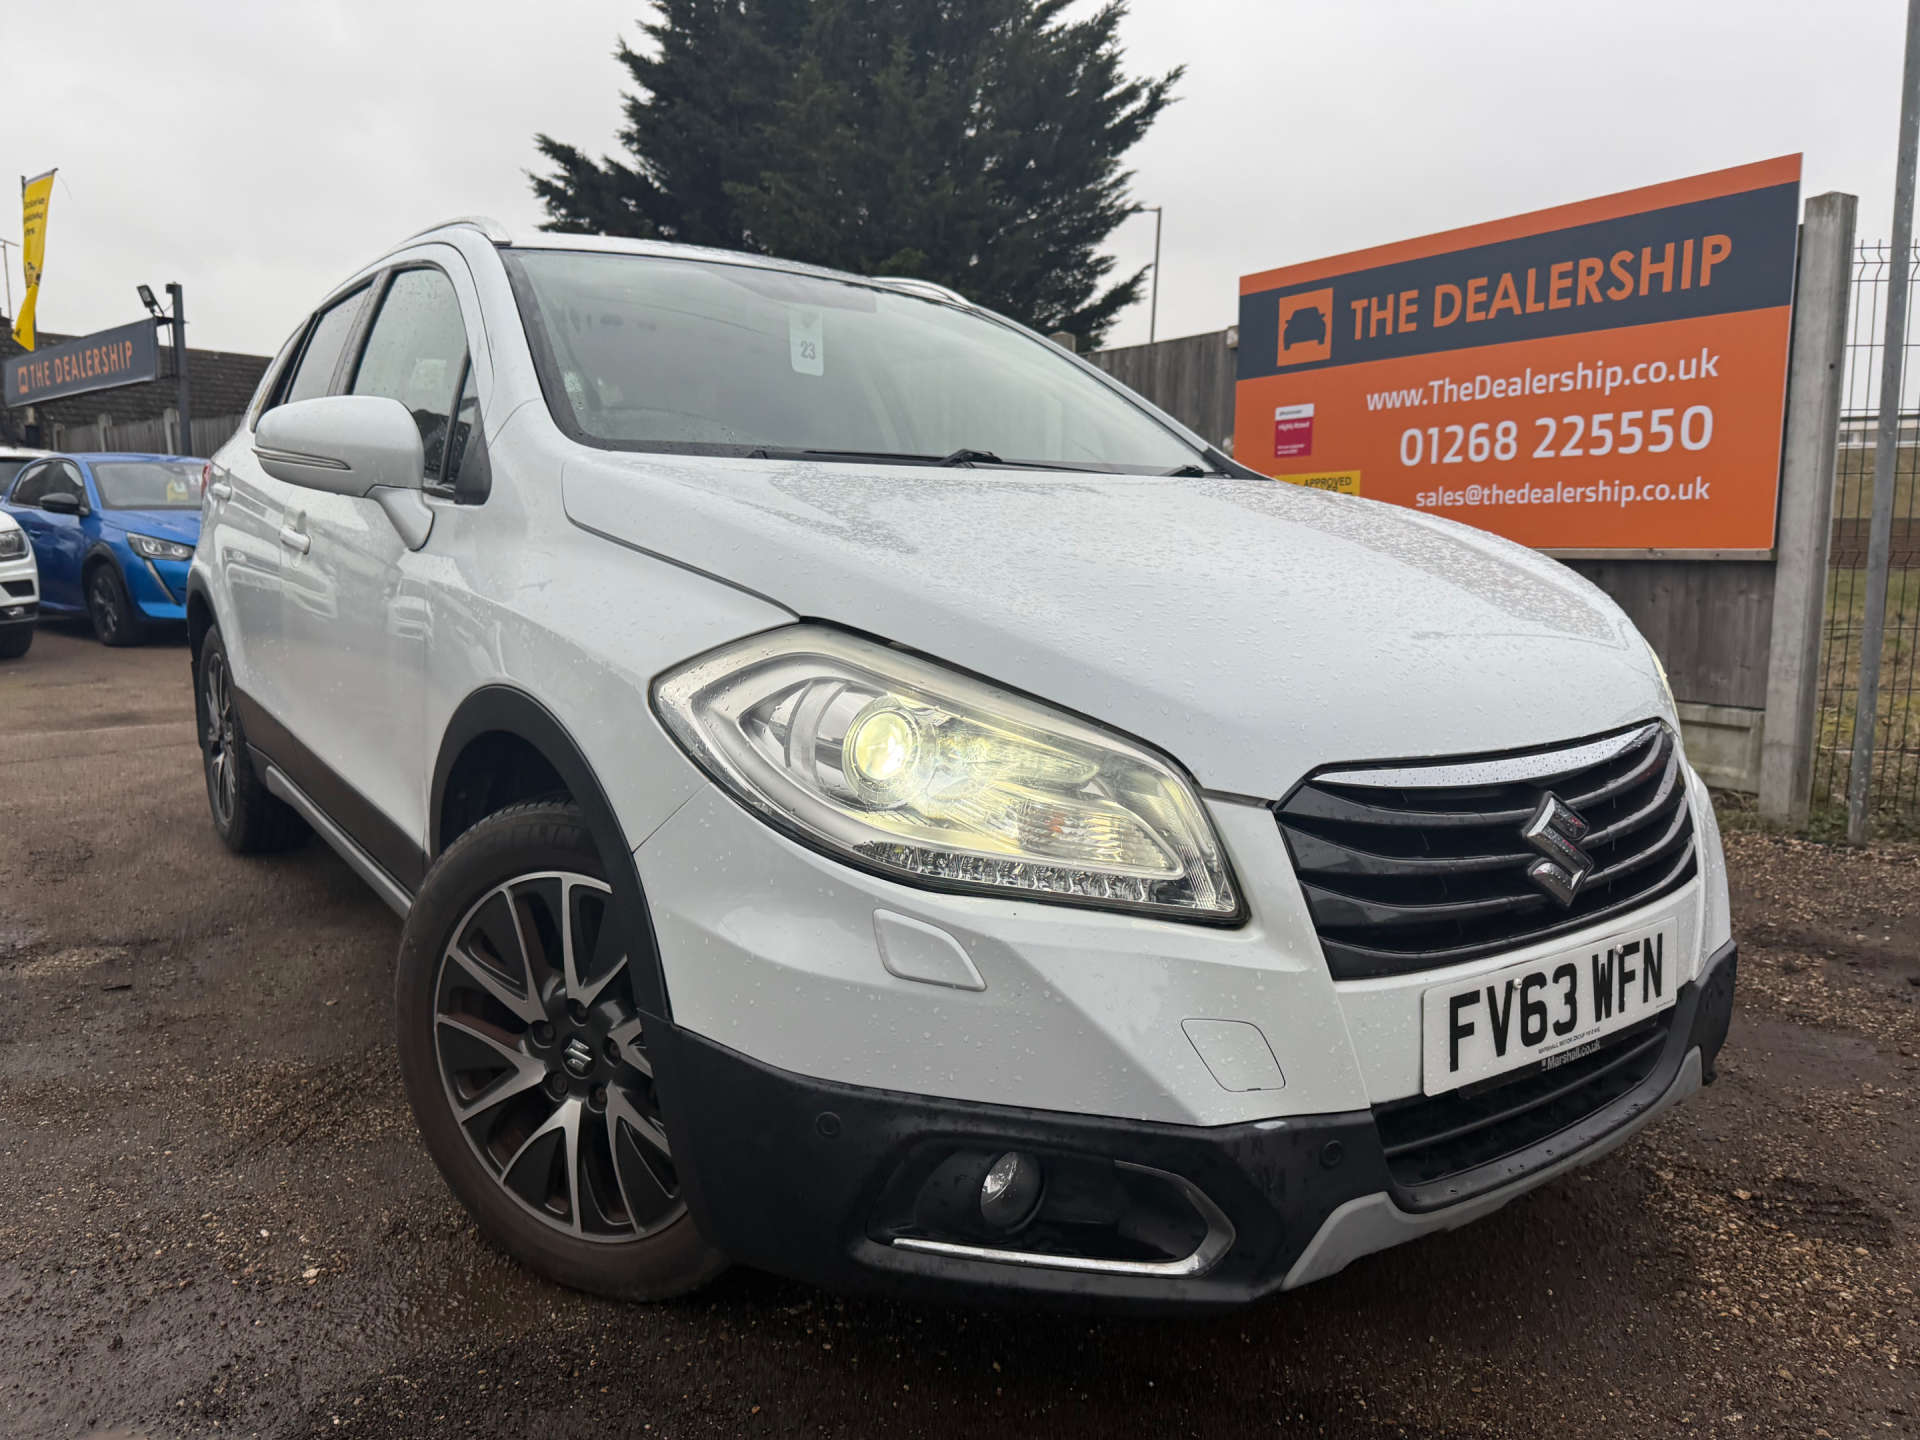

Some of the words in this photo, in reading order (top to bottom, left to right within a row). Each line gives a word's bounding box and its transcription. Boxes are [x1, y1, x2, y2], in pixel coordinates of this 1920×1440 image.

[1351, 289, 1419, 340] THE
[1433, 233, 1732, 328] DEALERSHIP
[30, 361, 51, 388] THE
[54, 341, 132, 384] DEALERSHIP
[800, 340, 816, 360] 23
[1366, 347, 1720, 411] www.TheDealership.co.uk
[1400, 420, 1518, 467] 01268
[1532, 405, 1714, 458] 225550
[1304, 476, 1352, 488] APPROVED
[1416, 476, 1711, 508] sales@thedealership.co.uk
[1449, 963, 1577, 1072] FV63
[1592, 932, 1663, 1023] WFN
